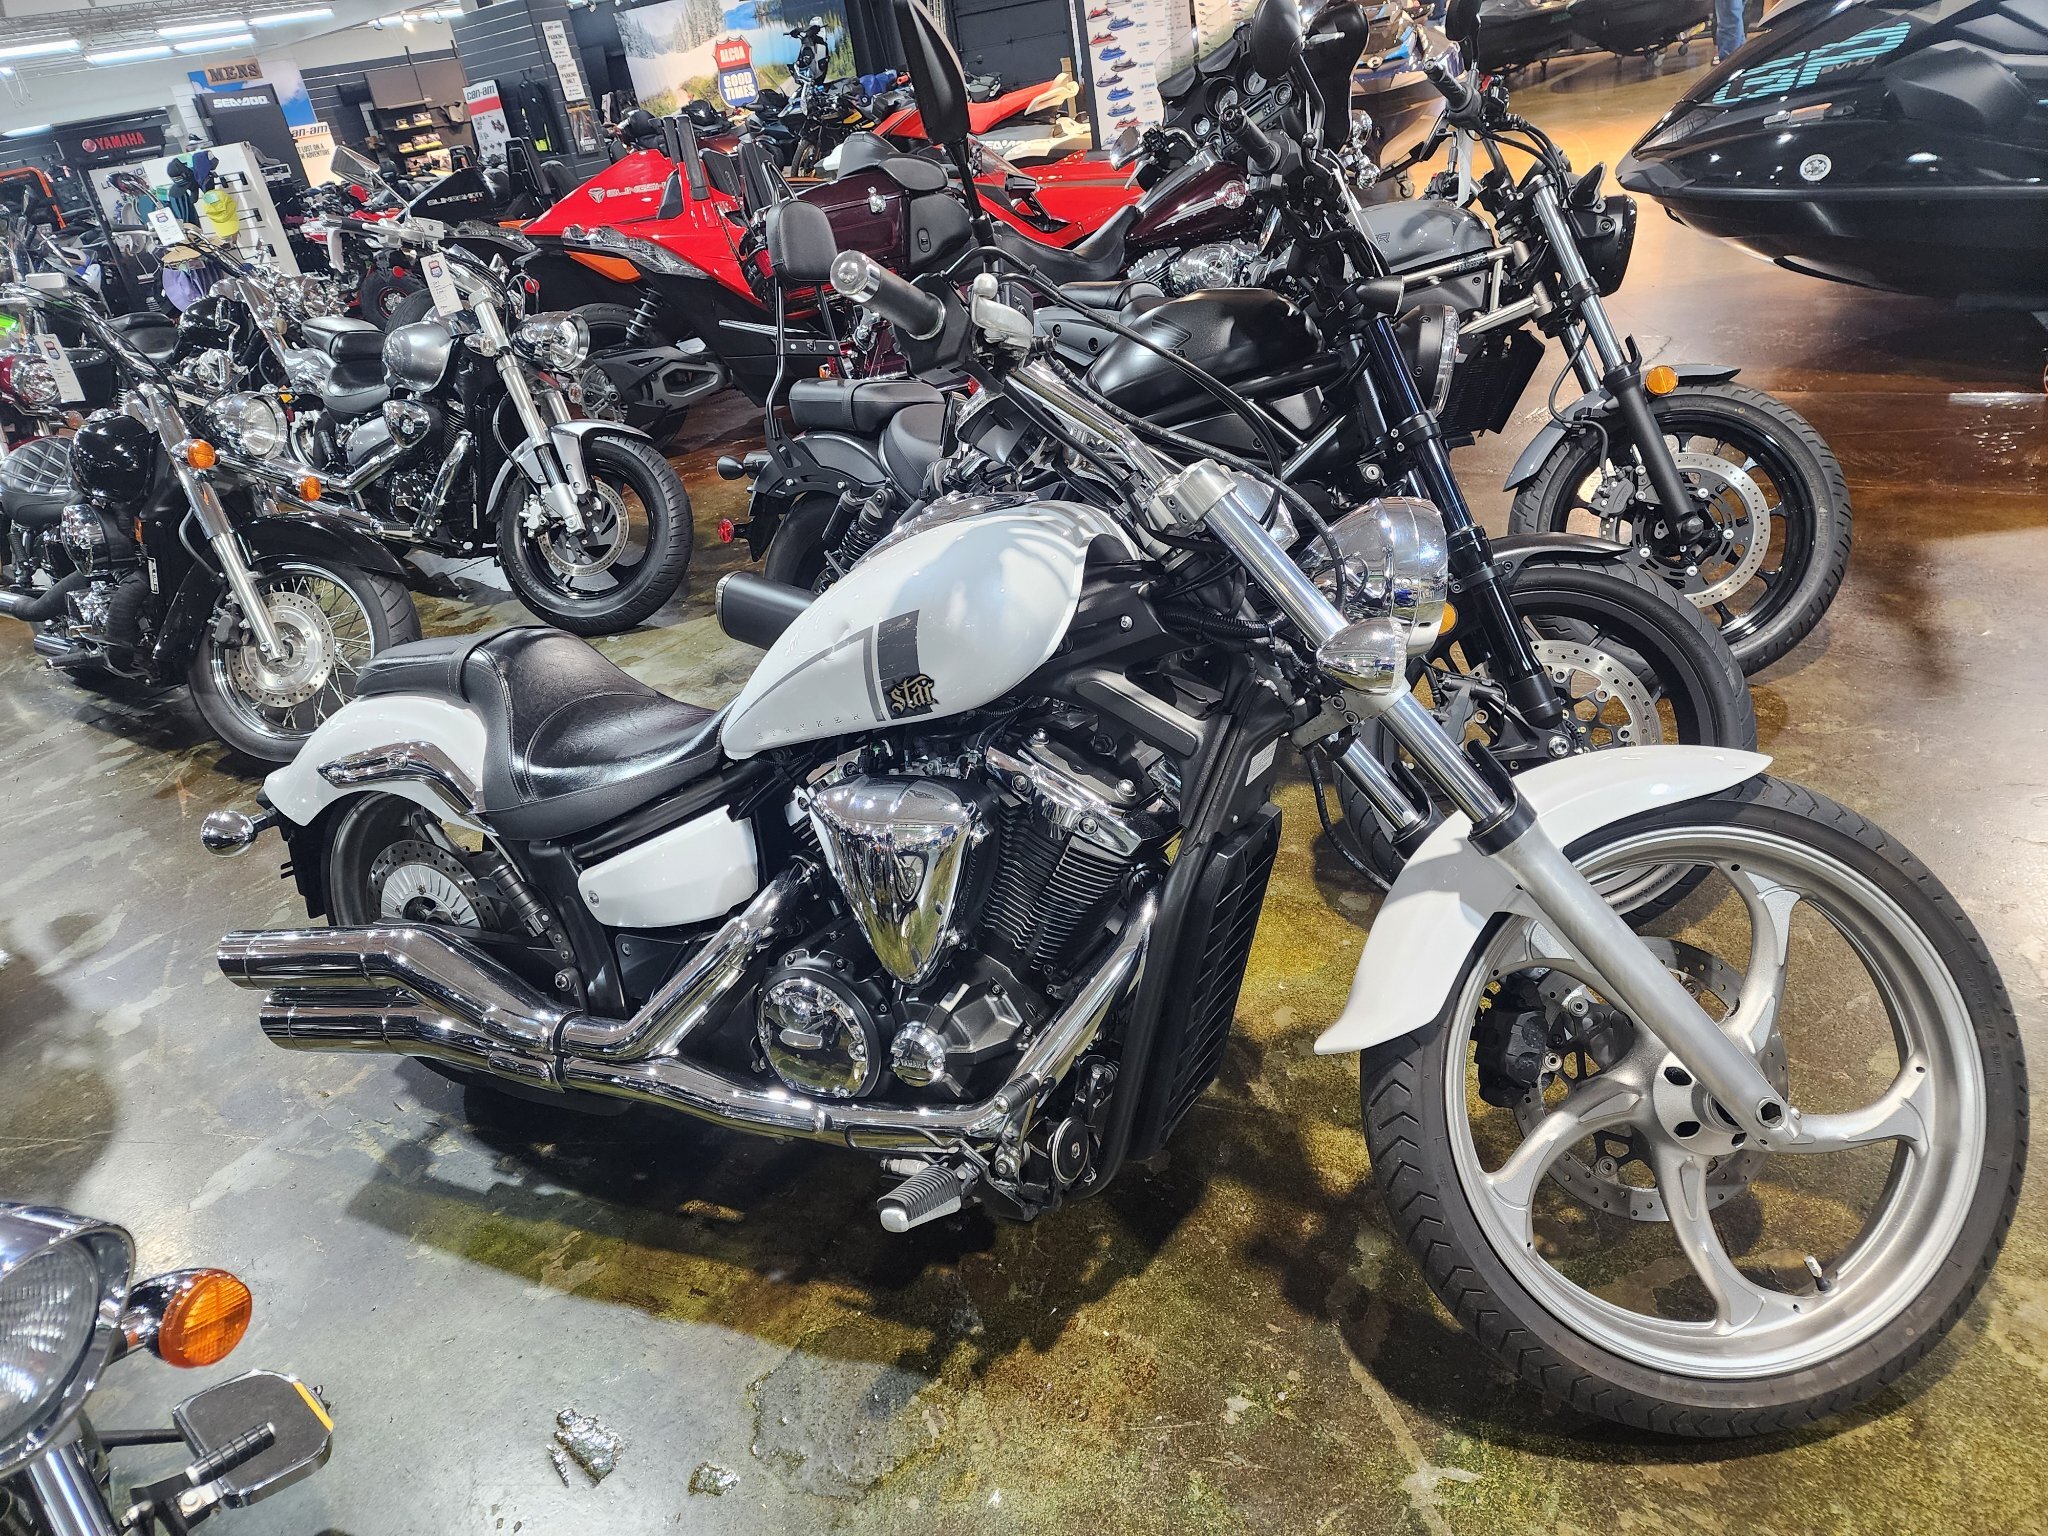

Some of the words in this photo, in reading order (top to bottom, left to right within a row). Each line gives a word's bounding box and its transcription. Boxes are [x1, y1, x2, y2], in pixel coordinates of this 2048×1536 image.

[719, 46, 746, 63] ALCOA
[207, 63, 258, 82] MENS
[723, 71, 753, 88] GOOD
[466, 85, 495, 100] can-am
[724, 84, 756, 100] TIMES
[291, 125, 328, 138] an-am
[95, 131, 146, 150] YAMAHA
[757, 713, 861, 740] STRYKER
